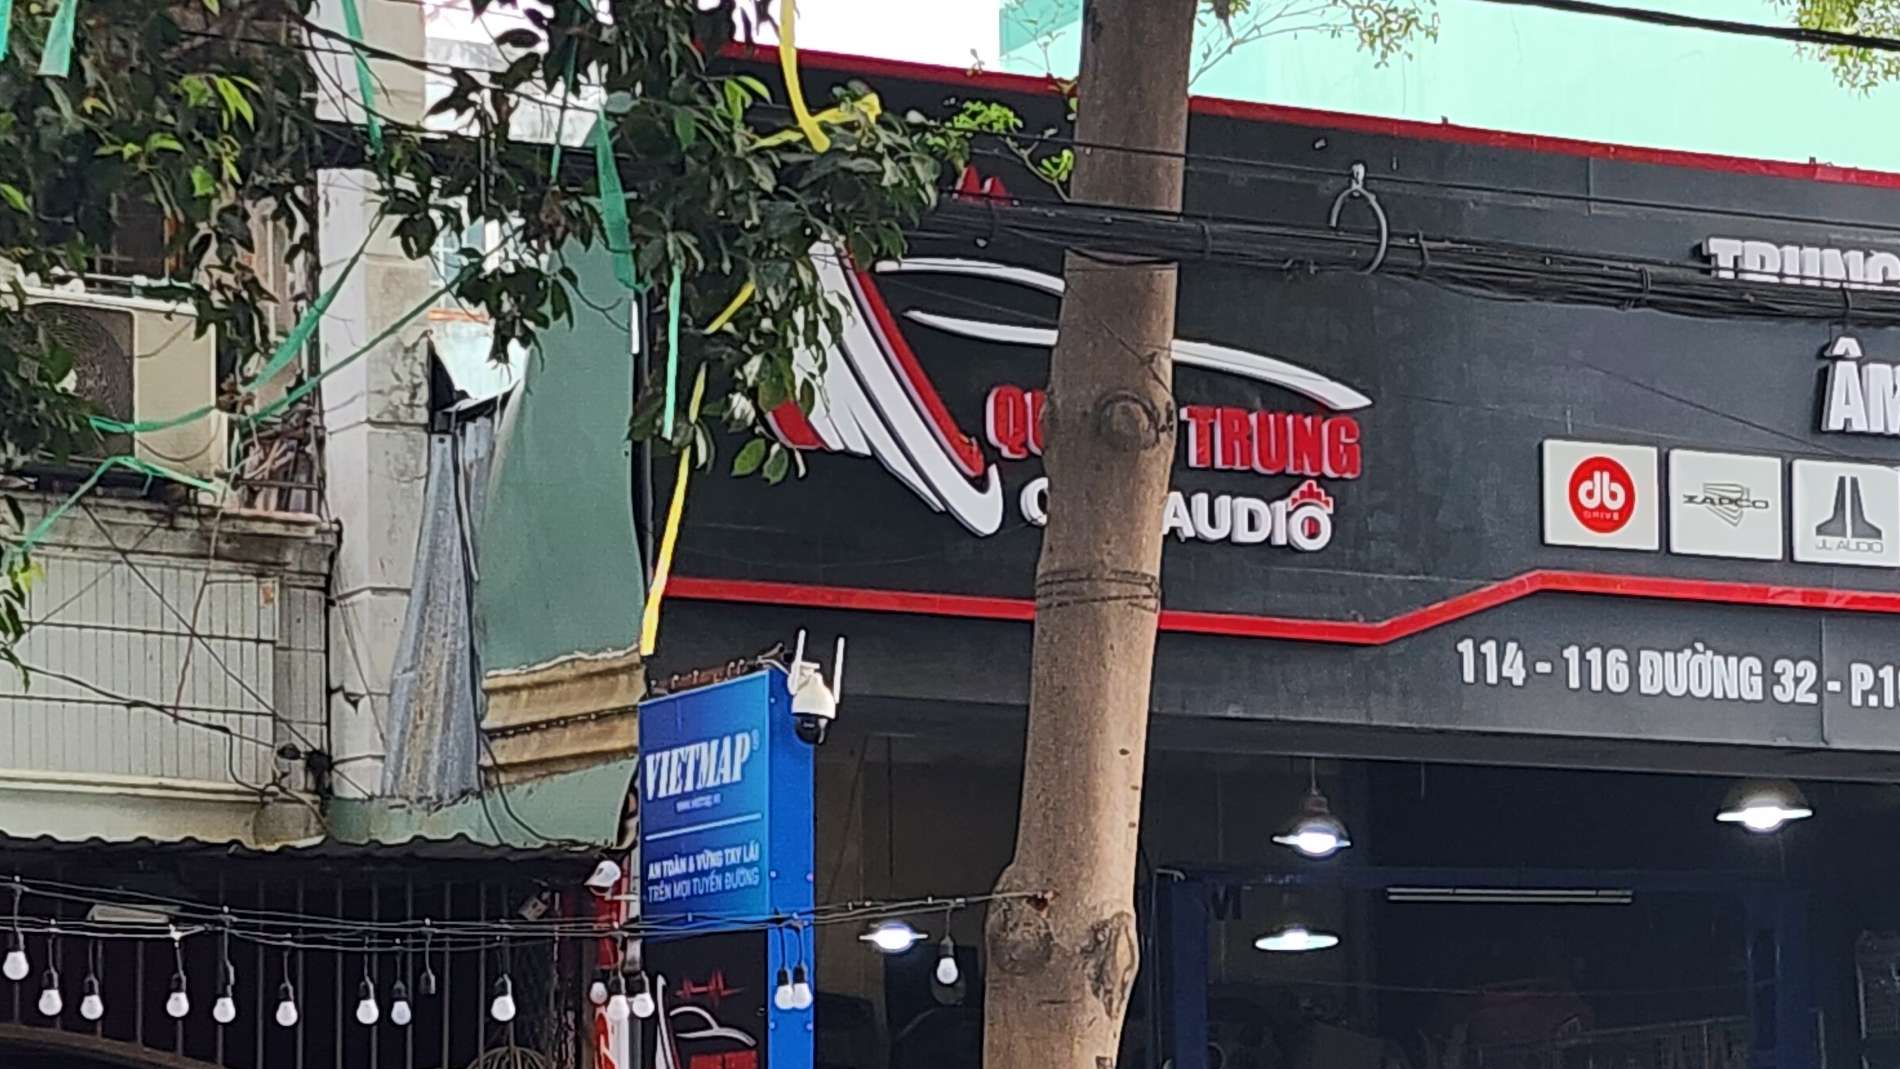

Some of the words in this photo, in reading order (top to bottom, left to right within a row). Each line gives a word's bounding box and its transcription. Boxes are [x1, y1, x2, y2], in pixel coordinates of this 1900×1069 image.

[1180, 405, 1362, 478] TRUNG
[1162, 490, 1333, 551] AUDIO
[1578, 470, 1626, 509] db
[1456, 638, 1526, 686] 114
[1562, 645, 1629, 692] 116
[1639, 642, 1763, 701] ĐƯỜNG
[1772, 659, 1818, 704] 32
[645, 732, 752, 802] VIETMAP
